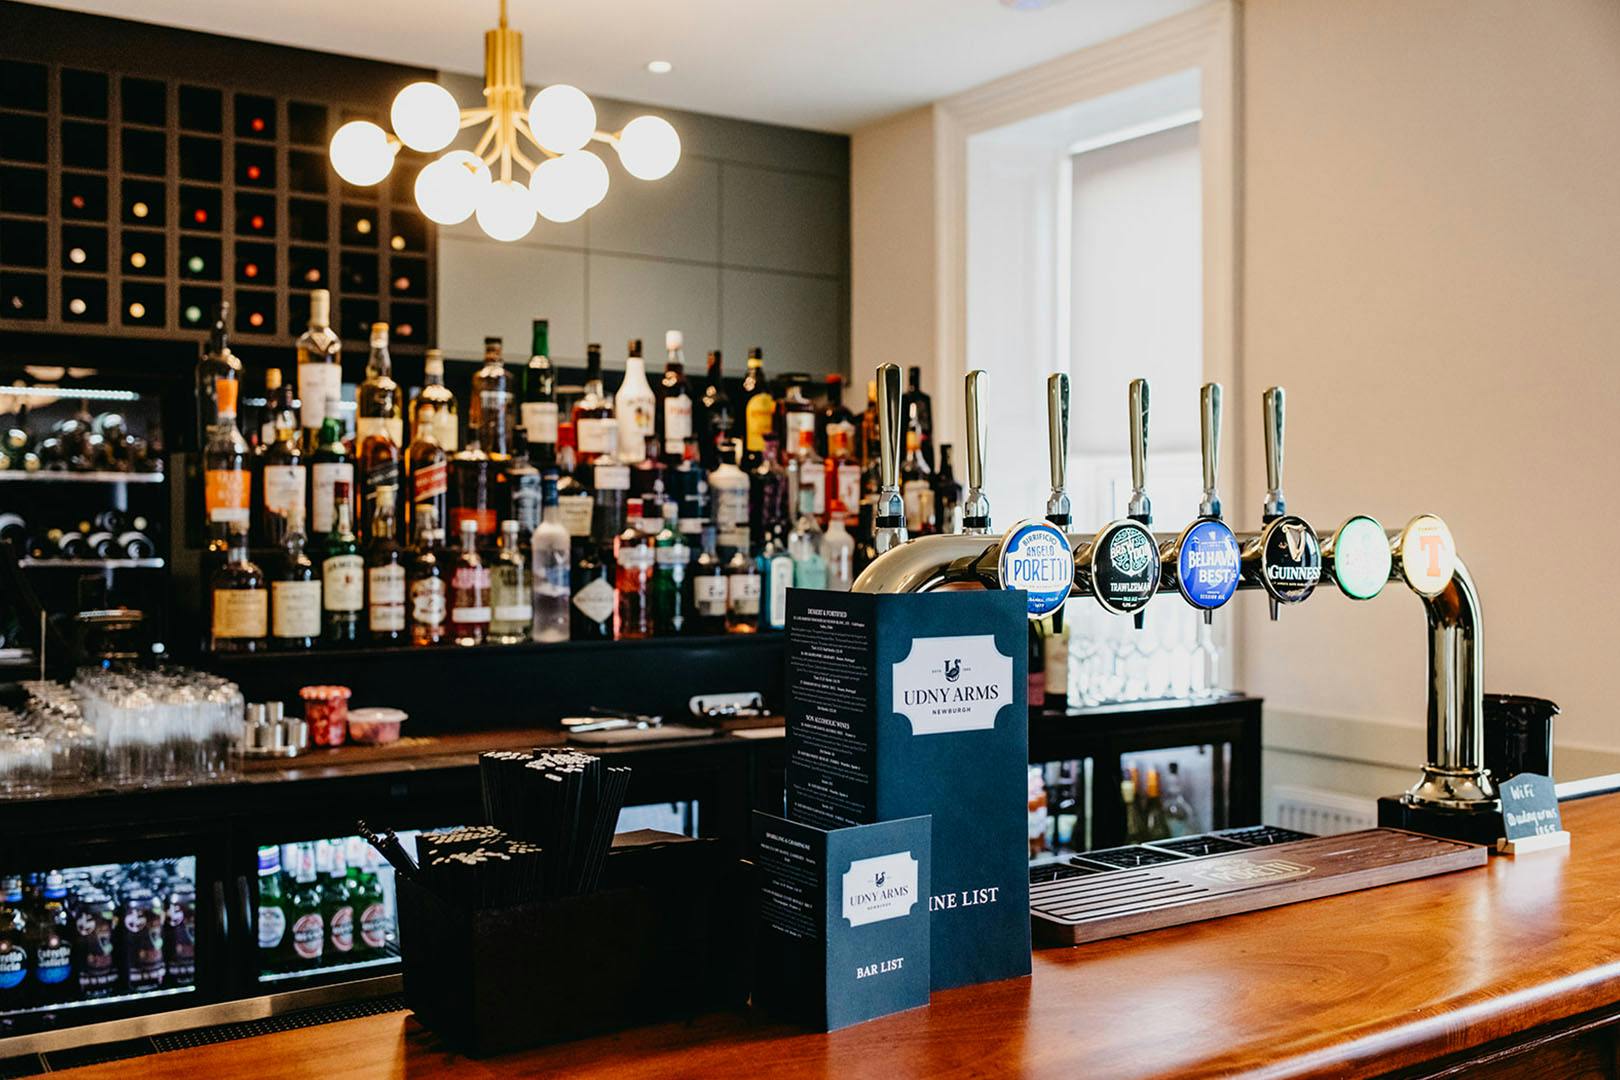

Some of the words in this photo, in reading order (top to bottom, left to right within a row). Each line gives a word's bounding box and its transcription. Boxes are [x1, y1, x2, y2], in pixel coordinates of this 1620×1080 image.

[1022, 533, 1058, 546] BIRRIFICIO
[1026, 545, 1055, 557] ANGELO
[1420, 536, 1445, 577] T
[1014, 558, 1067, 581] PORETTI
[1199, 569, 1231, 583] BEST
[1269, 564, 1321, 580] GUINNESS
[904, 687, 950, 705] UDNY
[953, 684, 999, 704] ARMS
[932, 707, 972, 715] NEWBURGH
[1510, 783, 1535, 800] WiFi
[850, 891, 877, 906] UDNY
[880, 885, 909, 900] ARMS
[929, 893, 957, 912] INE
[962, 887, 999, 906] LIST
[856, 964, 879, 979] BAR
[880, 957, 904, 973] LIST
